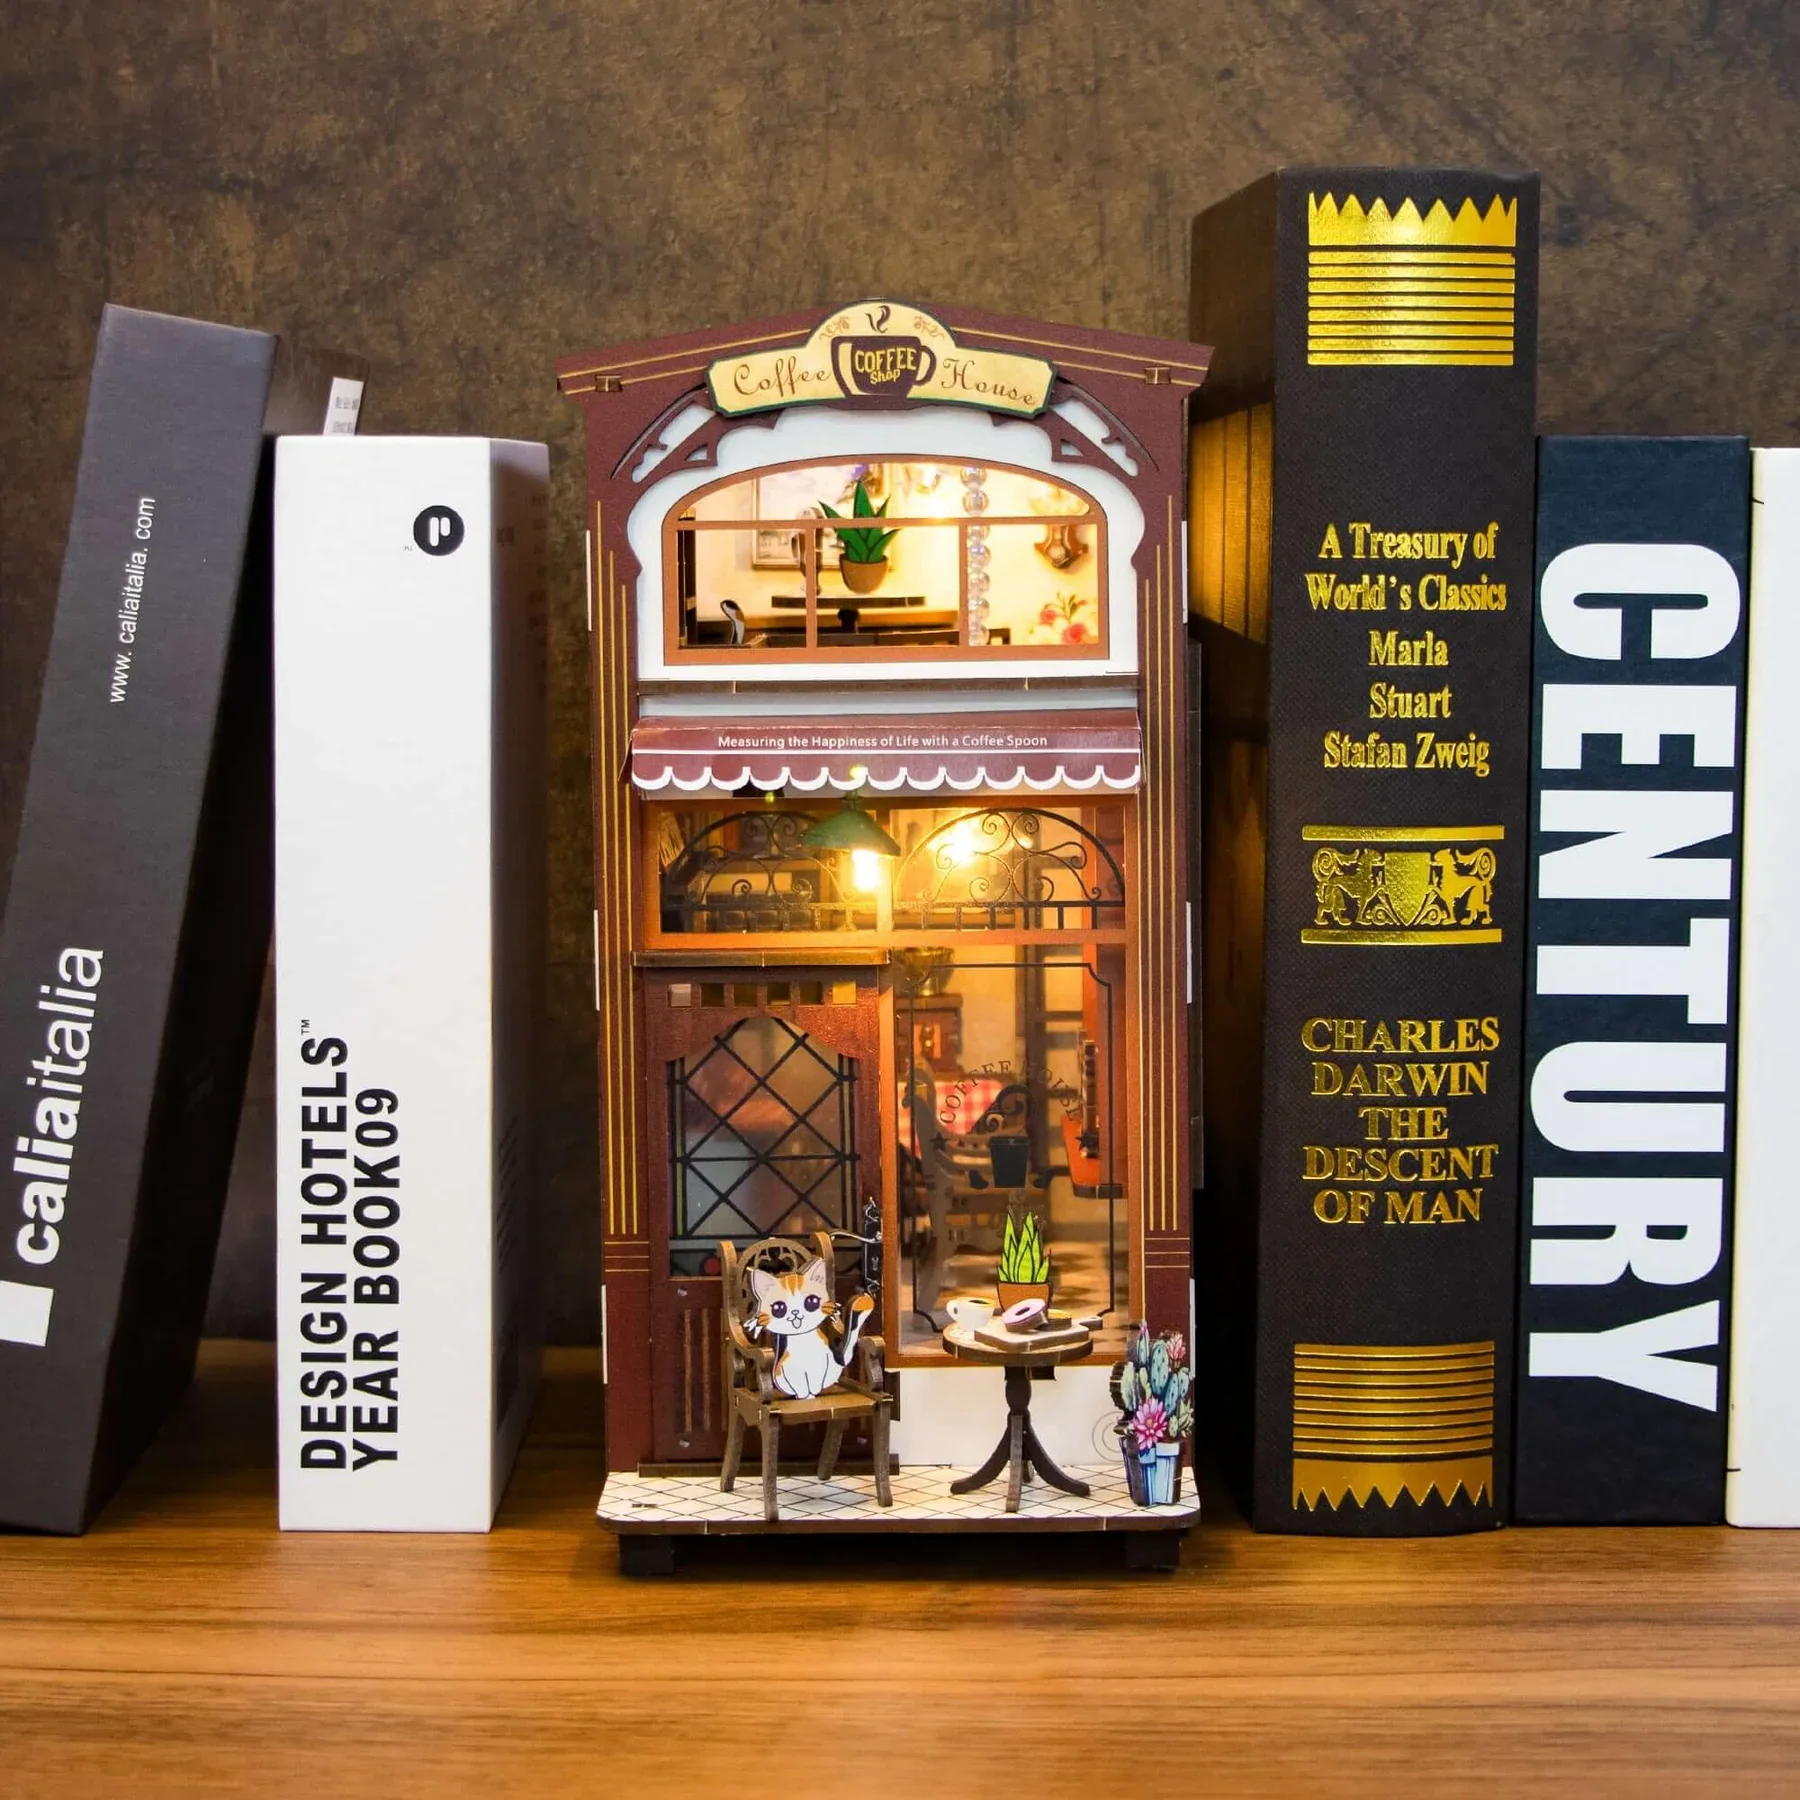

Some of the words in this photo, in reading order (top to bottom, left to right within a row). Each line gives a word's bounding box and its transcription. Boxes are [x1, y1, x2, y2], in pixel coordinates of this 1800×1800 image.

[855, 347, 917, 373] COFFEE
[870, 369, 900, 385] Shop
[734, 356, 831, 397] Coffee
[940, 357, 1036, 406] House
[1318, 523, 1343, 558] A
[1349, 522, 1469, 569] Treasury
[1473, 521, 1499, 559] of
[1418, 573, 1507, 611] Classics
[1368, 630, 1449, 666] Marla
[1369, 682, 1452, 718] Stuart
[718, 736, 785, 749] Measuring
[788, 736, 809, 747] the
[812, 736, 877, 749] Happiness
[882, 736, 893, 747] of
[896, 736, 919, 746] Life
[922, 736, 949, 746] with
[952, 737, 959, 746] a
[962, 735, 1003, 746] Coffee
[1006, 735, 1048, 748] Spoon
[1324, 731, 1408, 768] Stafan
[1415, 732, 1490, 777] Zweig
[1528, 543, 1741, 1412] CENTURY
[1301, 1017, 1500, 1053] CHARLES
[939, 1060, 1011, 1125] COFFEE
[1310, 1061, 1490, 1097] DARWIN
[13, 947, 104, 1265] caliaitalia
[1358, 1107, 1449, 1141] THE
[1301, 1144, 1500, 1181] DESCENT
[352, 1088, 400, 1305] BOOK09
[1313, 1190, 1376, 1224] OF
[1383, 1188, 1484, 1224] MAN
[300, 1272, 348, 1470] DESIGN
[352, 1331, 399, 1472] YEAR
